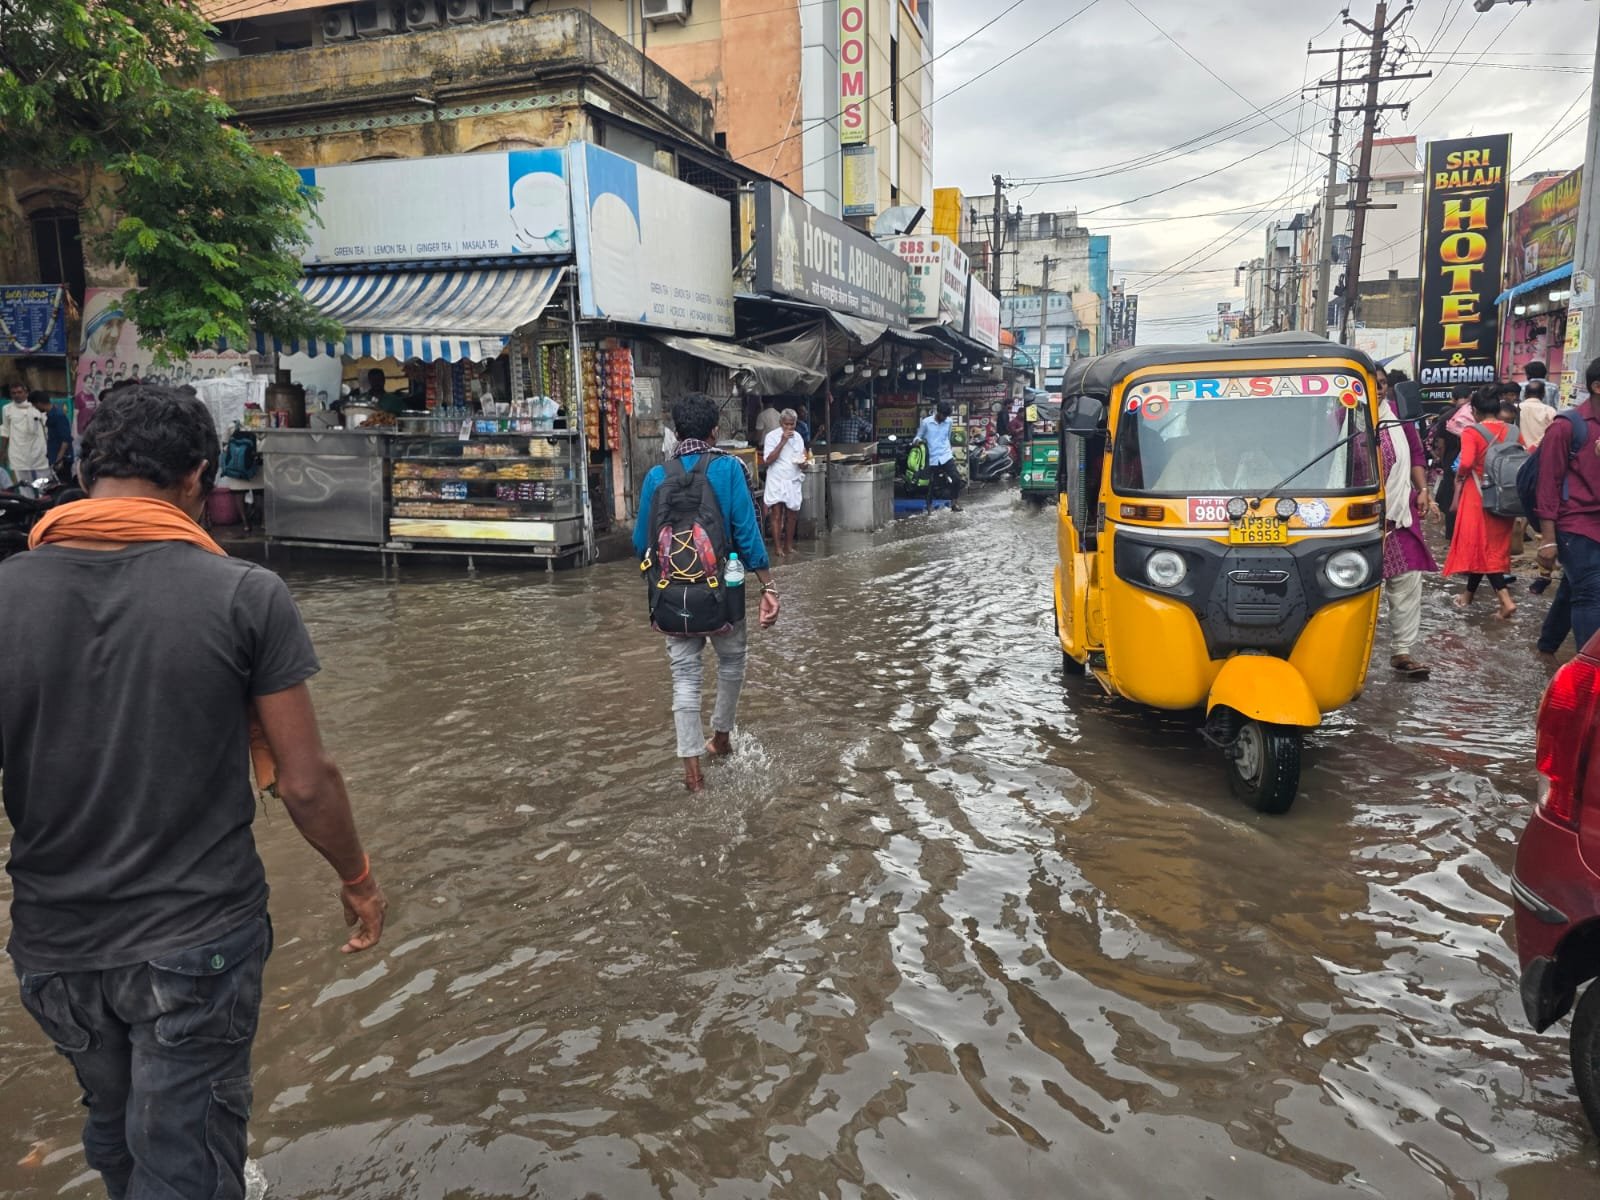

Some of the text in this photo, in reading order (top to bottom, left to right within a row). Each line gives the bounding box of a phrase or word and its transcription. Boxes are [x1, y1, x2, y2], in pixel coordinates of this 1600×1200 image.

[1446, 148, 1490, 170] SRI
[1435, 166, 1502, 190] BALAJI
[334, 238, 499, 256] GREEN TEA LEMON TEA GINGER TEA MASALA TEA
[899, 241, 924, 254] SBS
[803, 221, 845, 281] HOTEL
[848, 245, 901, 305] ABHIRUCHI
[1439, 197, 1490, 351] HOTEL
[1113, 302, 1121, 330] HOTEL
[1449, 352, 1467, 366] &
[1421, 366, 1495, 384] CATERING
[1169, 374, 1330, 400] PRASAD
[1429, 391, 1446, 399] PURE
[1240, 530, 1281, 542] T6953
